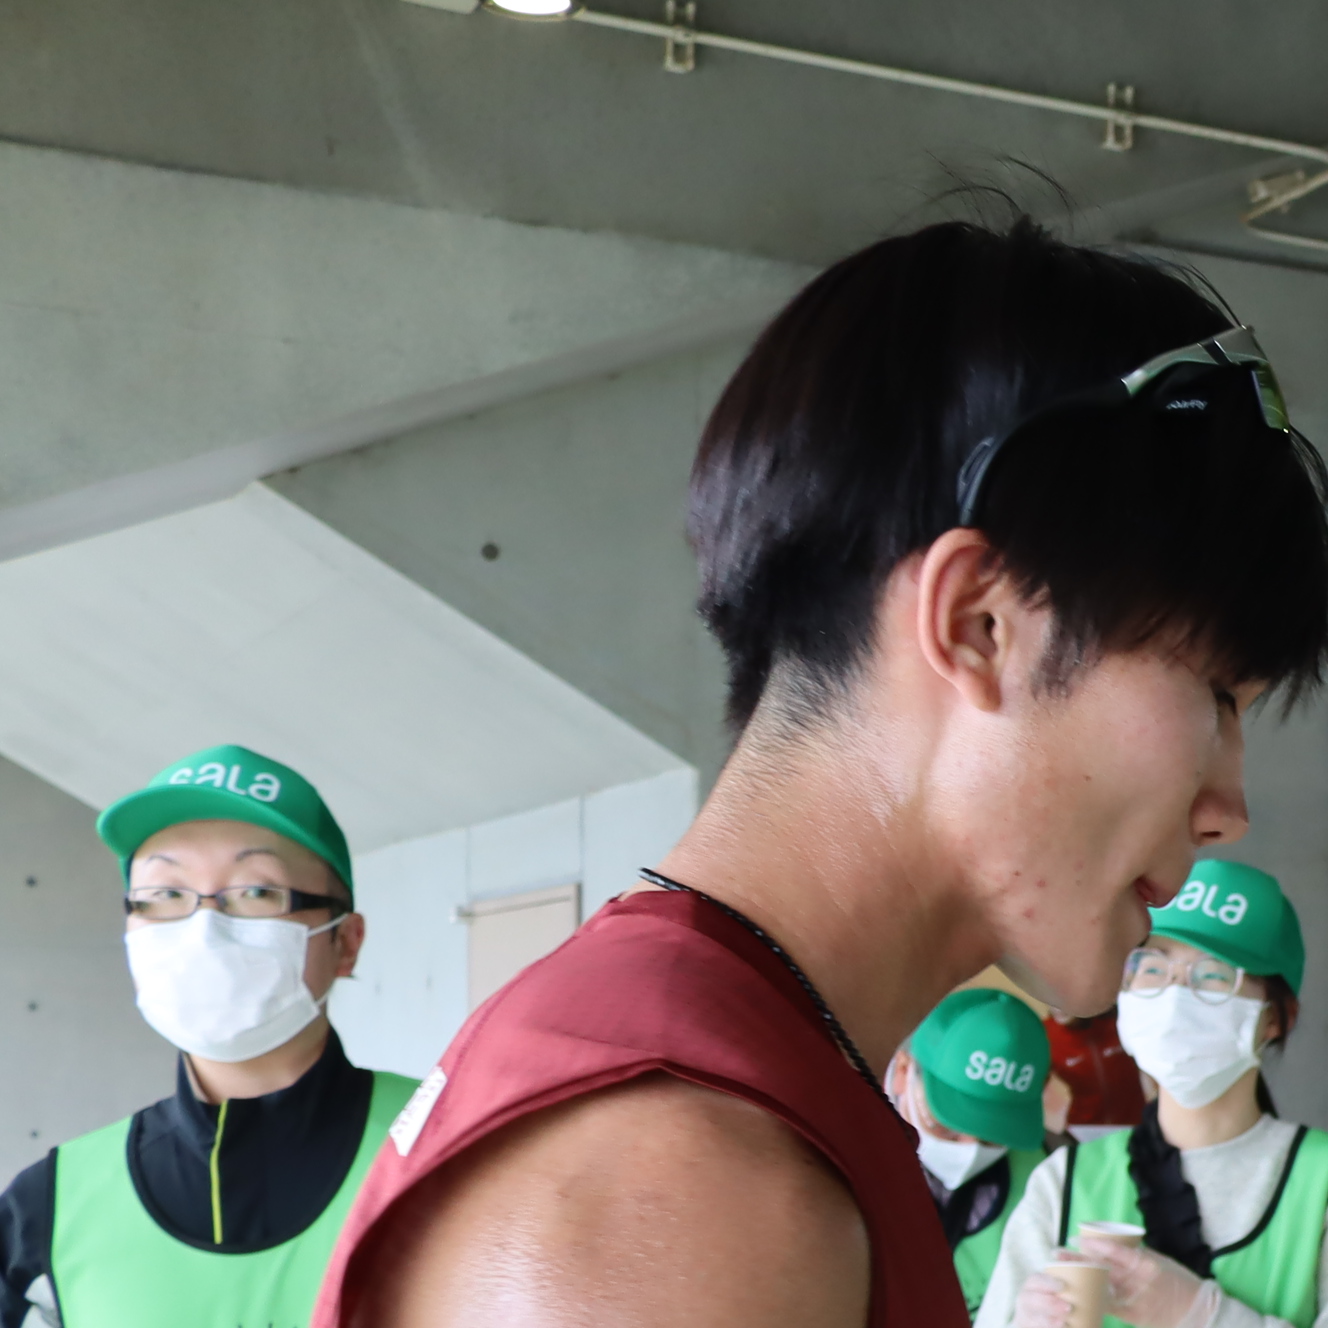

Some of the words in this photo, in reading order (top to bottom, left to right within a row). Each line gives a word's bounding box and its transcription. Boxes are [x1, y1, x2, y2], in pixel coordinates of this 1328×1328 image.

[168, 762, 281, 803] sala
[1158, 880, 1248, 926] ala
[964, 1049, 1035, 1093] sala
